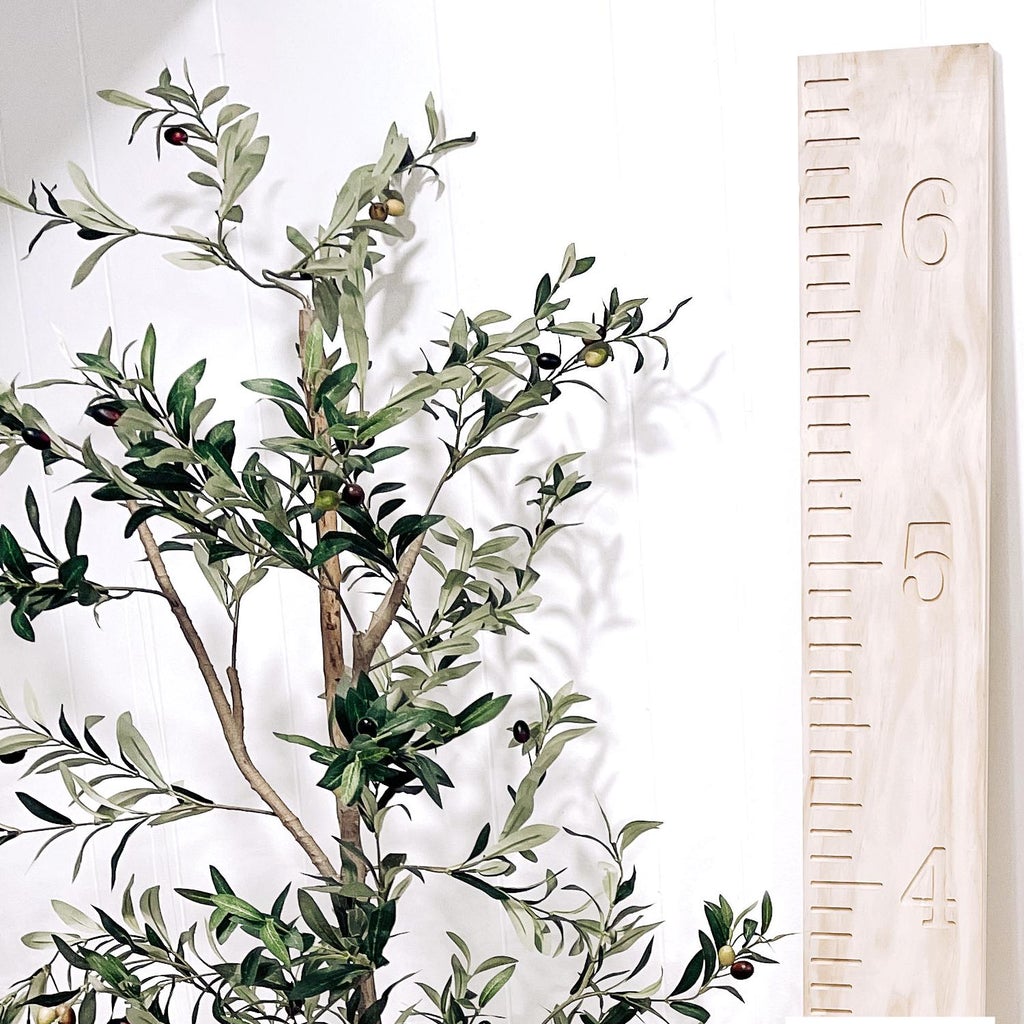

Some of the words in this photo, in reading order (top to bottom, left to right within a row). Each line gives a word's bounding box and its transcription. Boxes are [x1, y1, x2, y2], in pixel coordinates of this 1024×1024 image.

[901, 177, 958, 271] 6
[902, 522, 954, 602] 5
[899, 846, 956, 929] 4
